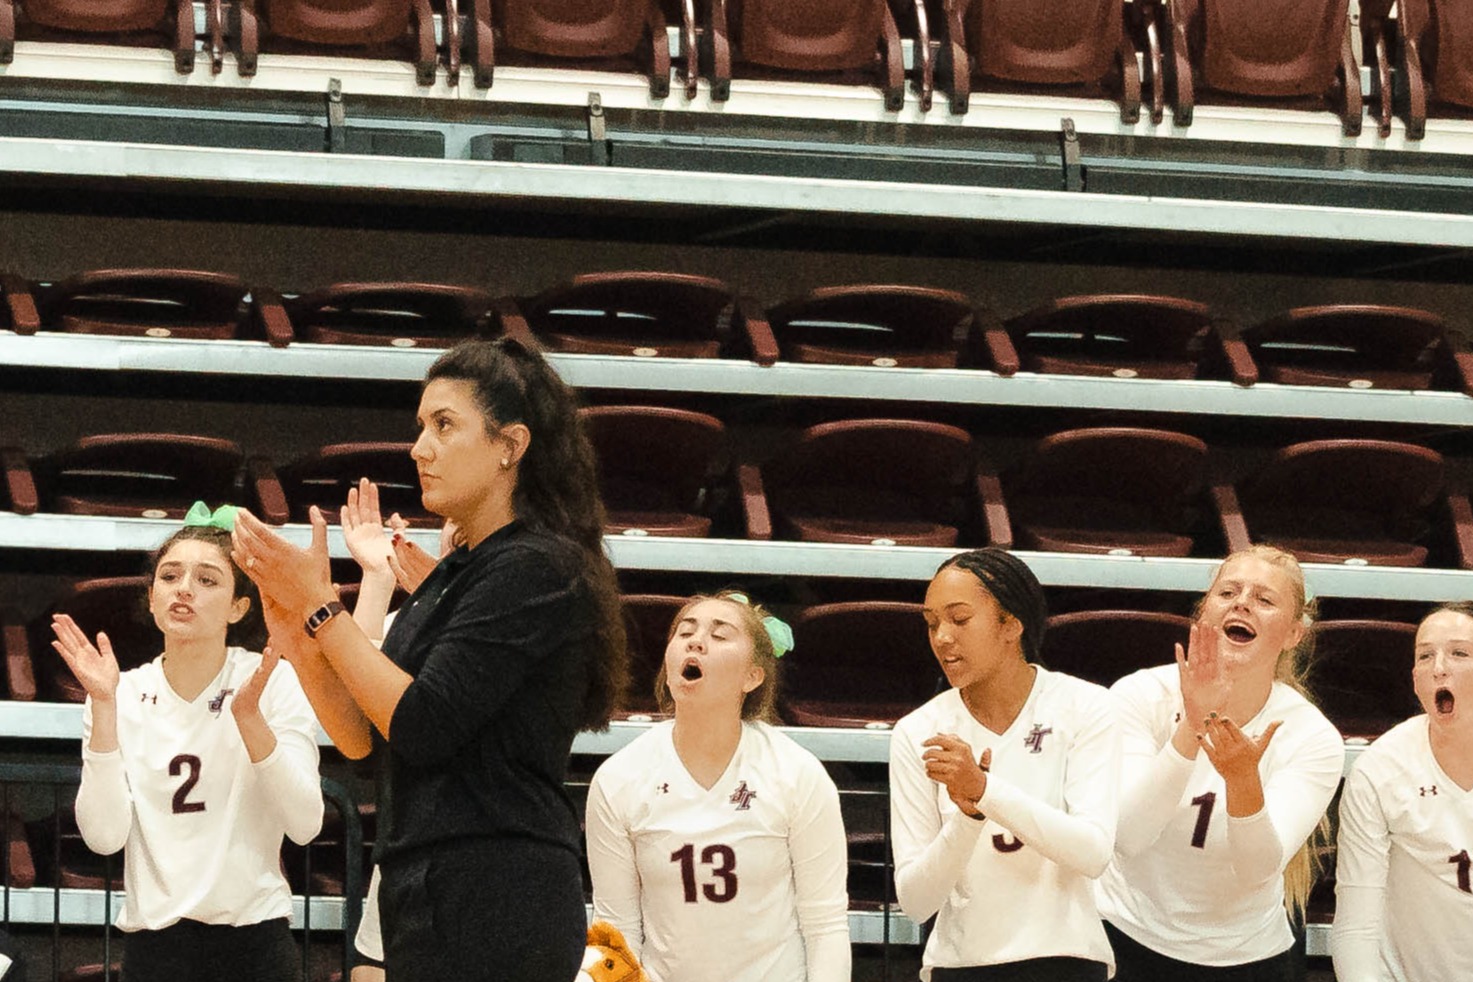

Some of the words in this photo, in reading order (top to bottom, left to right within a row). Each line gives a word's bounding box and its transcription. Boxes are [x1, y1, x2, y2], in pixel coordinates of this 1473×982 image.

[168, 754, 207, 814] 2
[1190, 792, 1217, 850] 1
[670, 844, 738, 903] 13
